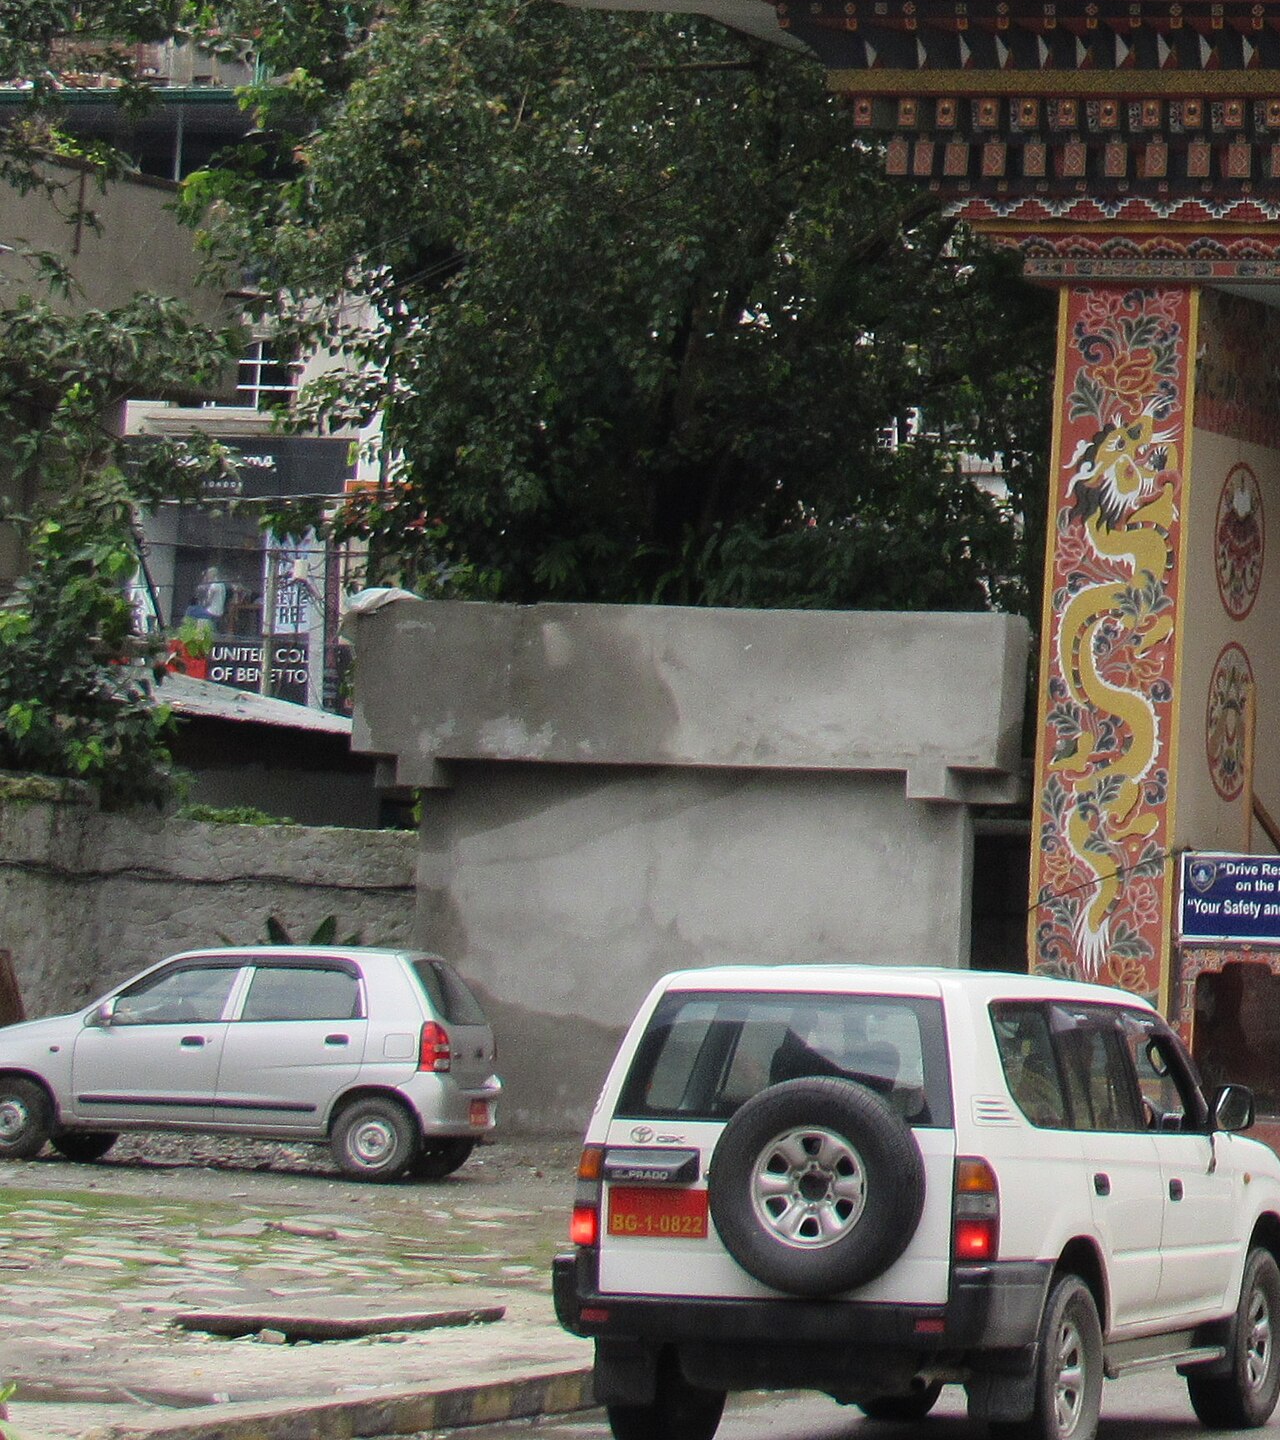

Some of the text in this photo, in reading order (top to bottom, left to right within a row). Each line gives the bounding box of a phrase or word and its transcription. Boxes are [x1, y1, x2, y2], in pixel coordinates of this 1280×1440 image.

[211, 666, 234, 681] OF
[1235, 881, 1252, 892] on
[1255, 880, 1274, 892] the
[1223, 899, 1261, 919] Safety
[629, 1170, 669, 1180] PRADO
[612, 1214, 703, 1234] BG-1-0822
